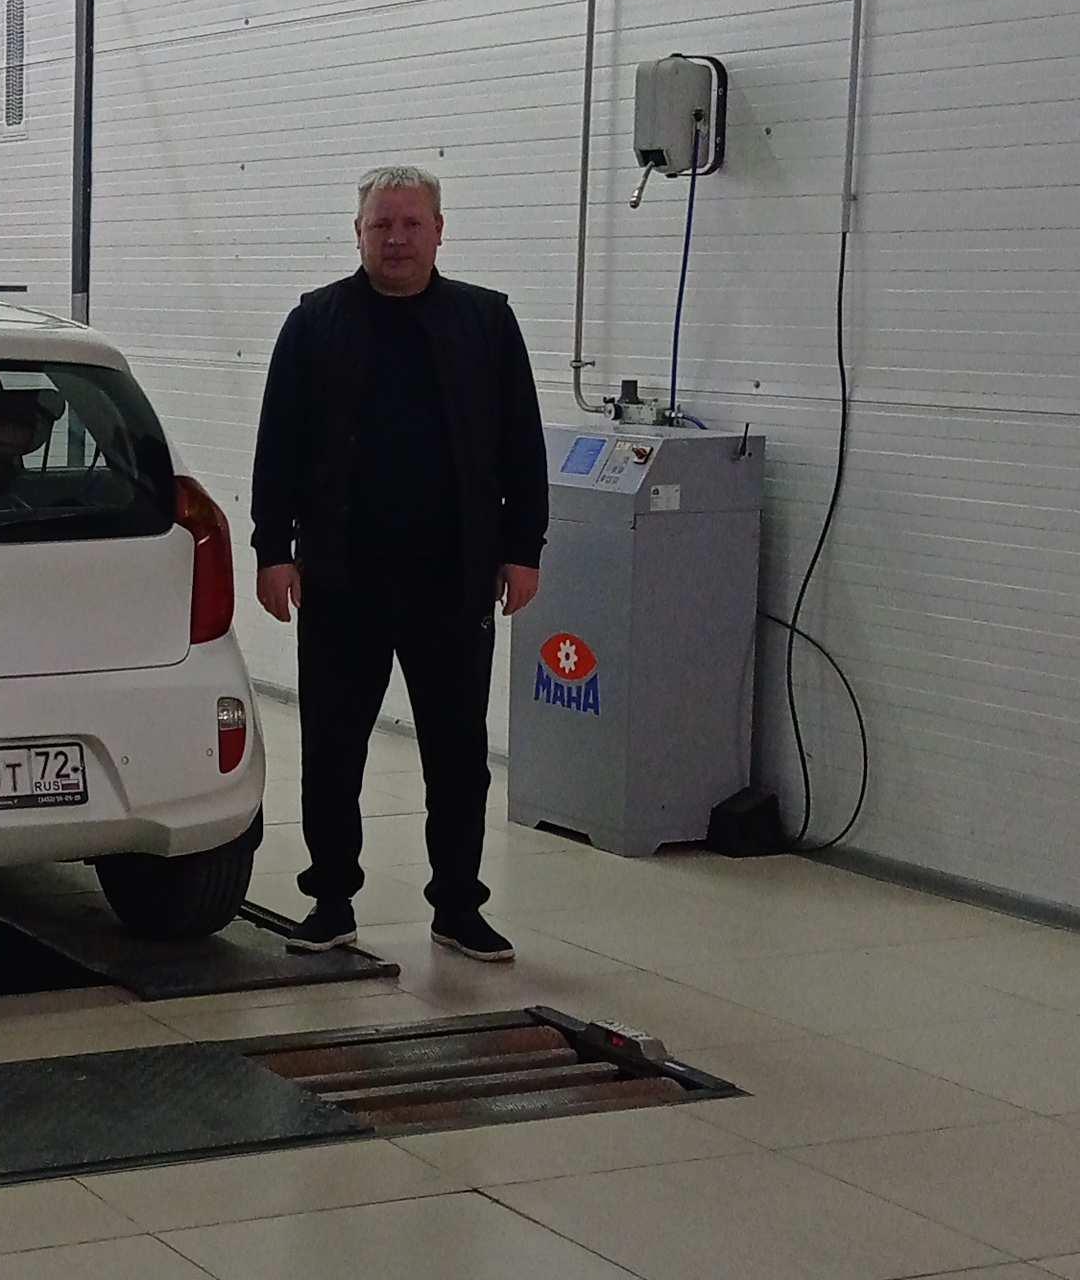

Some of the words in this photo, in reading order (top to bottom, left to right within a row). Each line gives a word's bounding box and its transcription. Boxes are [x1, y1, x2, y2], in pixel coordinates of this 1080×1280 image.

[534, 662, 600, 716] MAHA
[34, 751, 70, 780] 72
[34, 781, 60, 792] RUS
